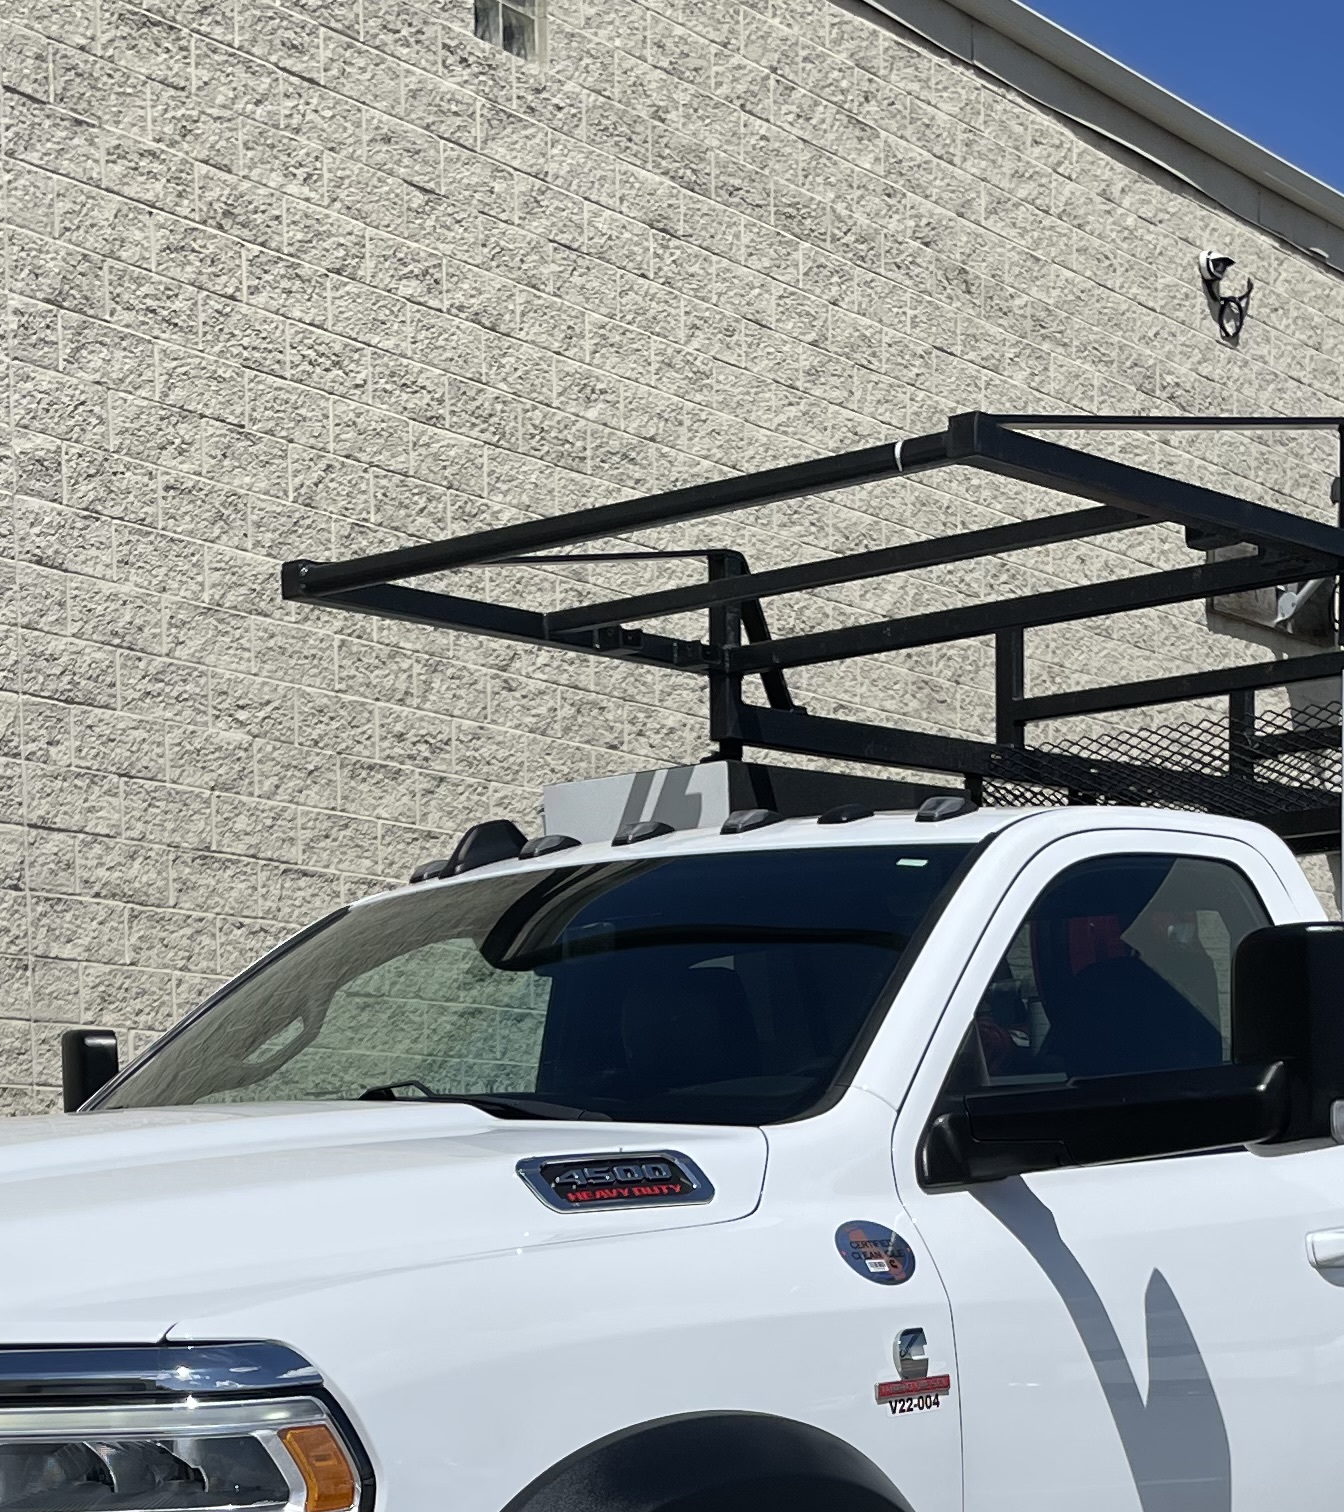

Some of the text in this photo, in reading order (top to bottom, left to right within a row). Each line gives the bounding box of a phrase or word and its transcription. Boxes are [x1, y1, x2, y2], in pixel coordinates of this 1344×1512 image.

[552, 1163, 673, 1189] 4500
[567, 1183, 682, 1202] HEAVY DUTY
[888, 1393, 941, 1415] V22-004
